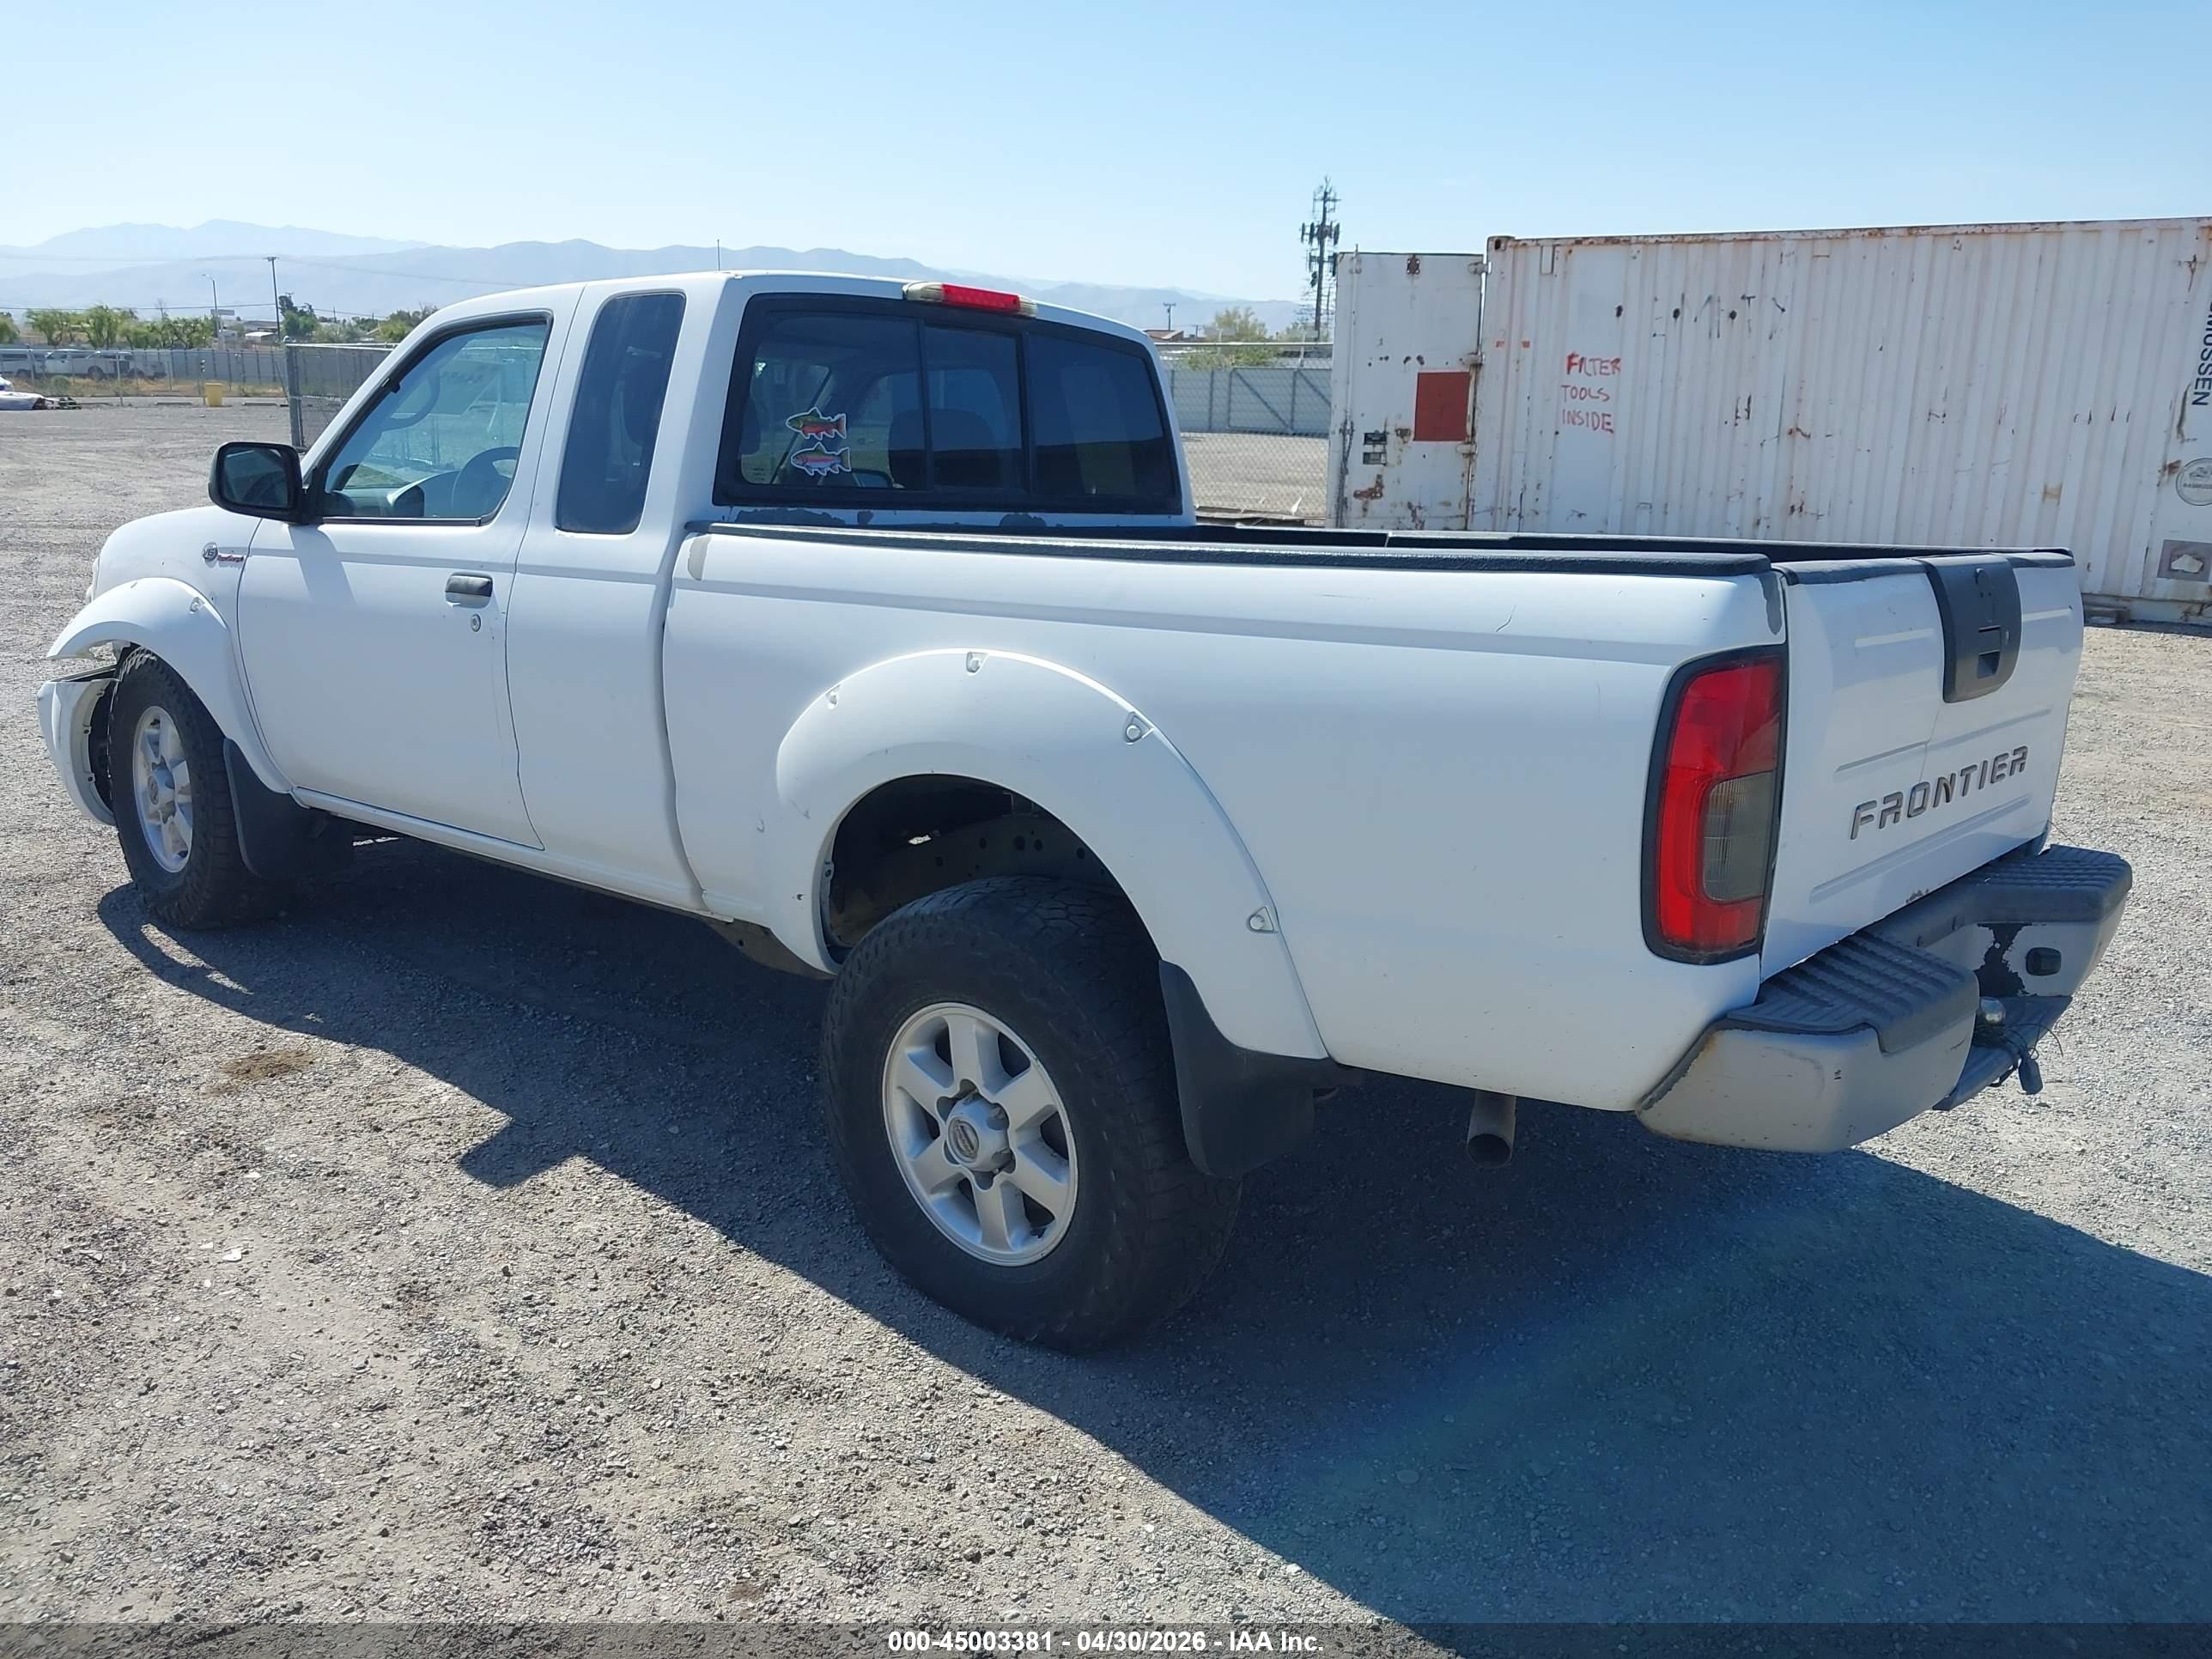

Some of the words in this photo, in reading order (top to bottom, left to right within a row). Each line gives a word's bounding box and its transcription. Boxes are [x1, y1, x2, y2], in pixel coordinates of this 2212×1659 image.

[1566, 352, 1621, 376] FILTER
[1561, 385, 1610, 403] TOOLS
[1562, 409, 1614, 434] INSIDE
[1850, 745, 2029, 840] FRONTIER
